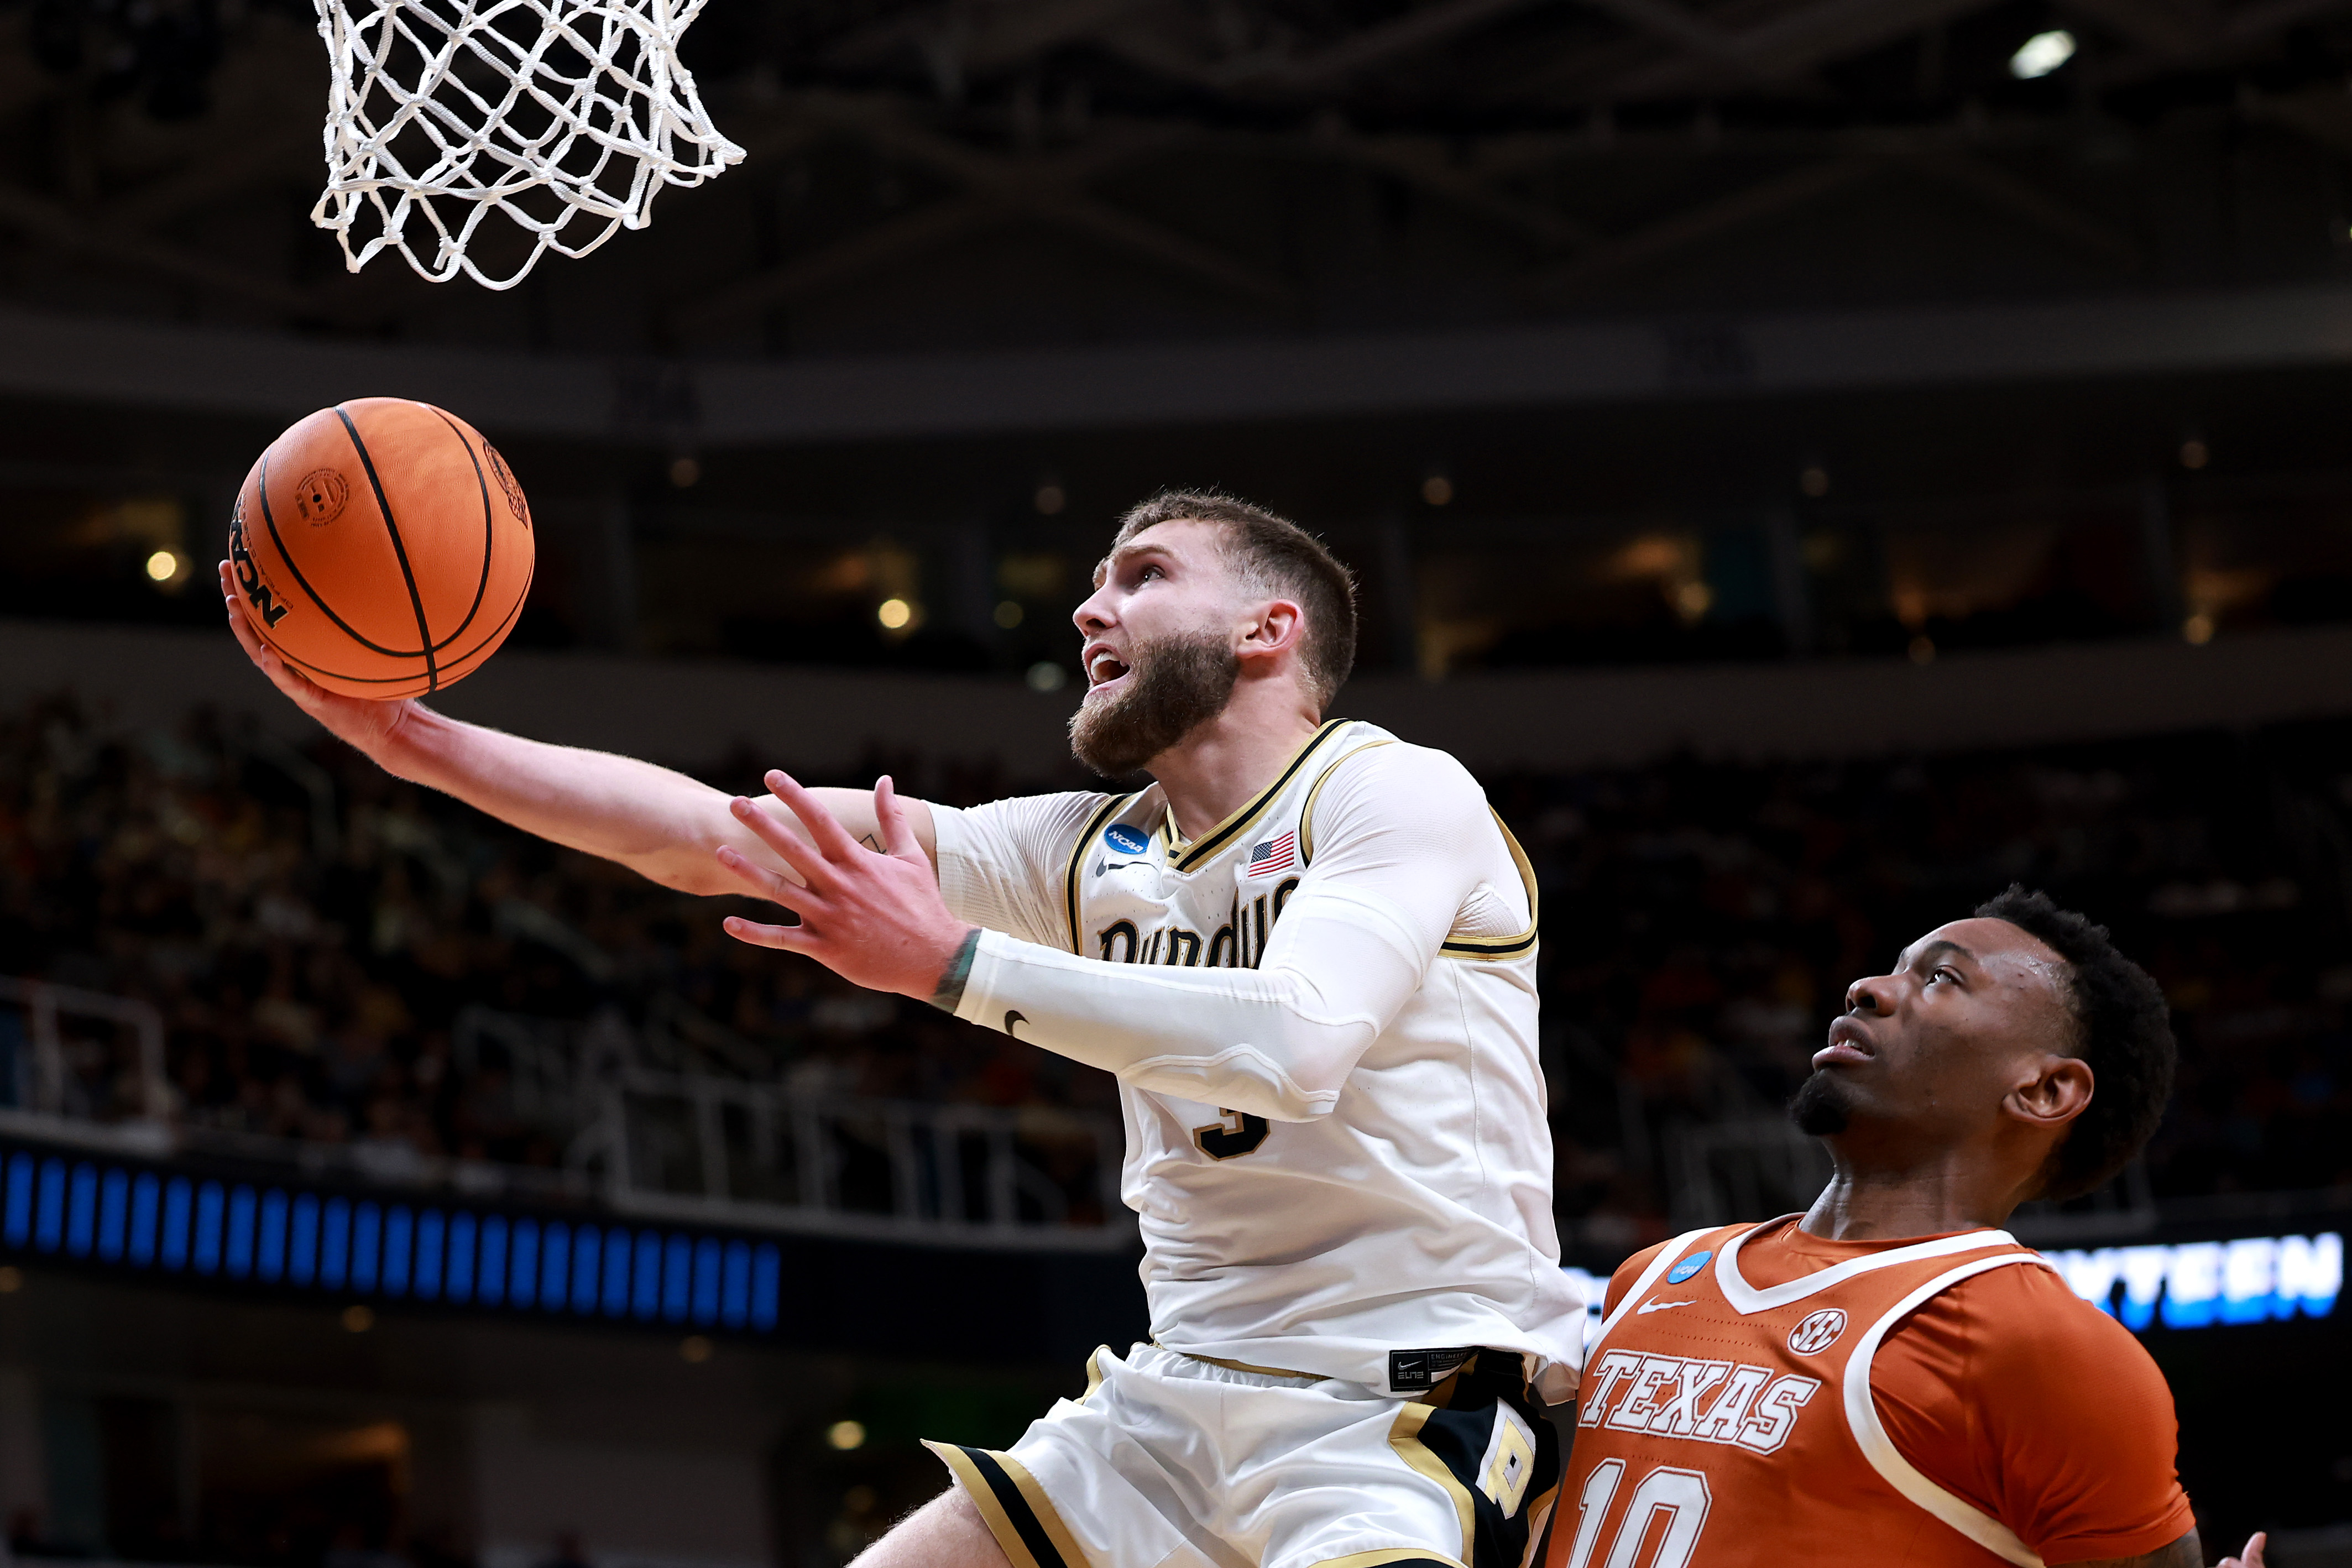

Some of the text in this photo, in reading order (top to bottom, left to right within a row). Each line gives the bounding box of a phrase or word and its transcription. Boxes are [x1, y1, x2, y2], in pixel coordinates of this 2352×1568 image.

[1108, 830, 1144, 852] NCAA
[1790, 1311, 1843, 1352] SEC
[1397, 1371, 1424, 1380] ELITE
[1579, 1349, 1822, 1456] TEXAS
[1566, 1457, 1712, 1568] 10
